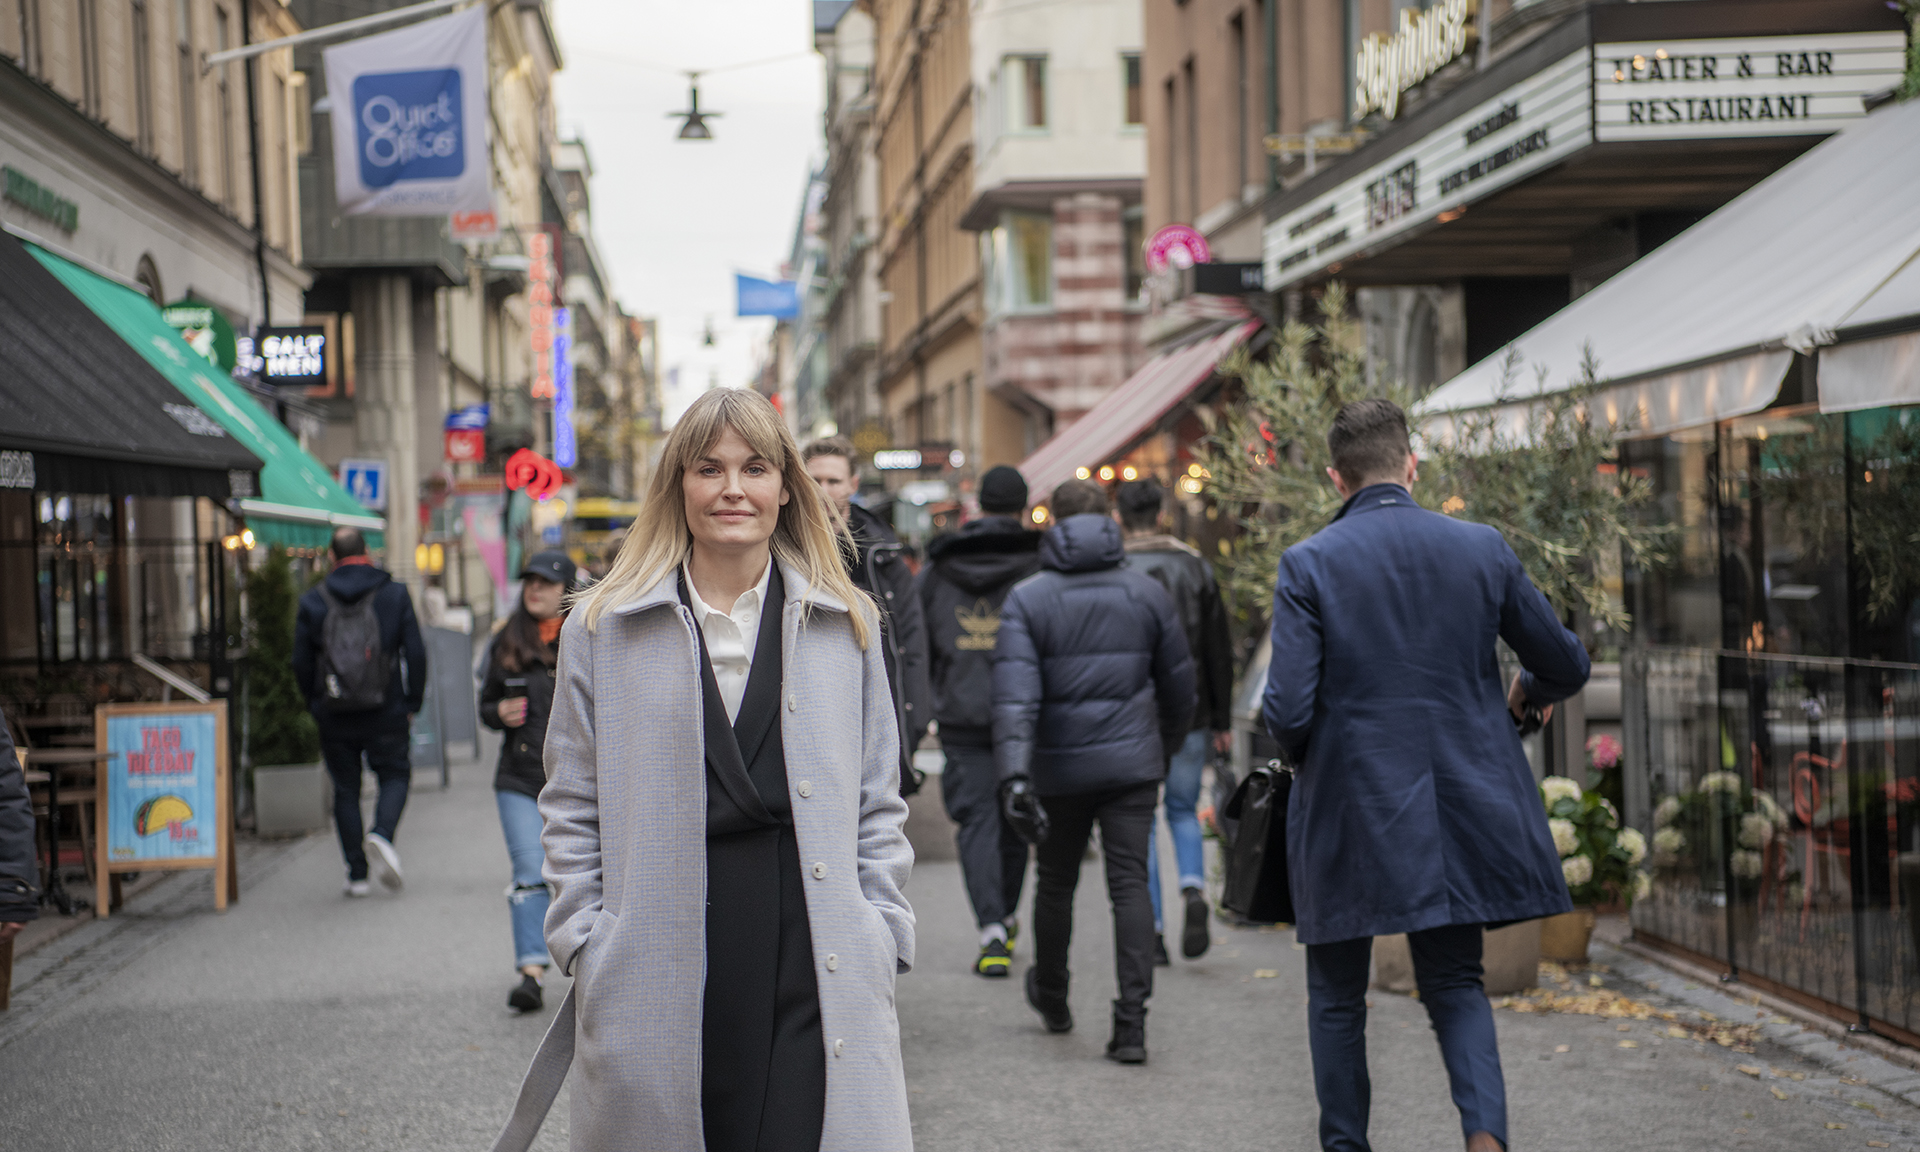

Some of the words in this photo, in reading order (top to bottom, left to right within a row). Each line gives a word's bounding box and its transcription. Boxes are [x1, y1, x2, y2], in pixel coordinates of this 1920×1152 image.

[1613, 56, 1717, 81] TEATER
[1737, 54, 1754, 78] &
[1776, 51, 1833, 77] BAR
[362, 91, 454, 134] Quick
[1628, 94, 1811, 123] RESTAURANT
[365, 126, 457, 167] Office
[140, 726, 181, 751] TACO
[126, 750, 195, 775] TUESDAY
